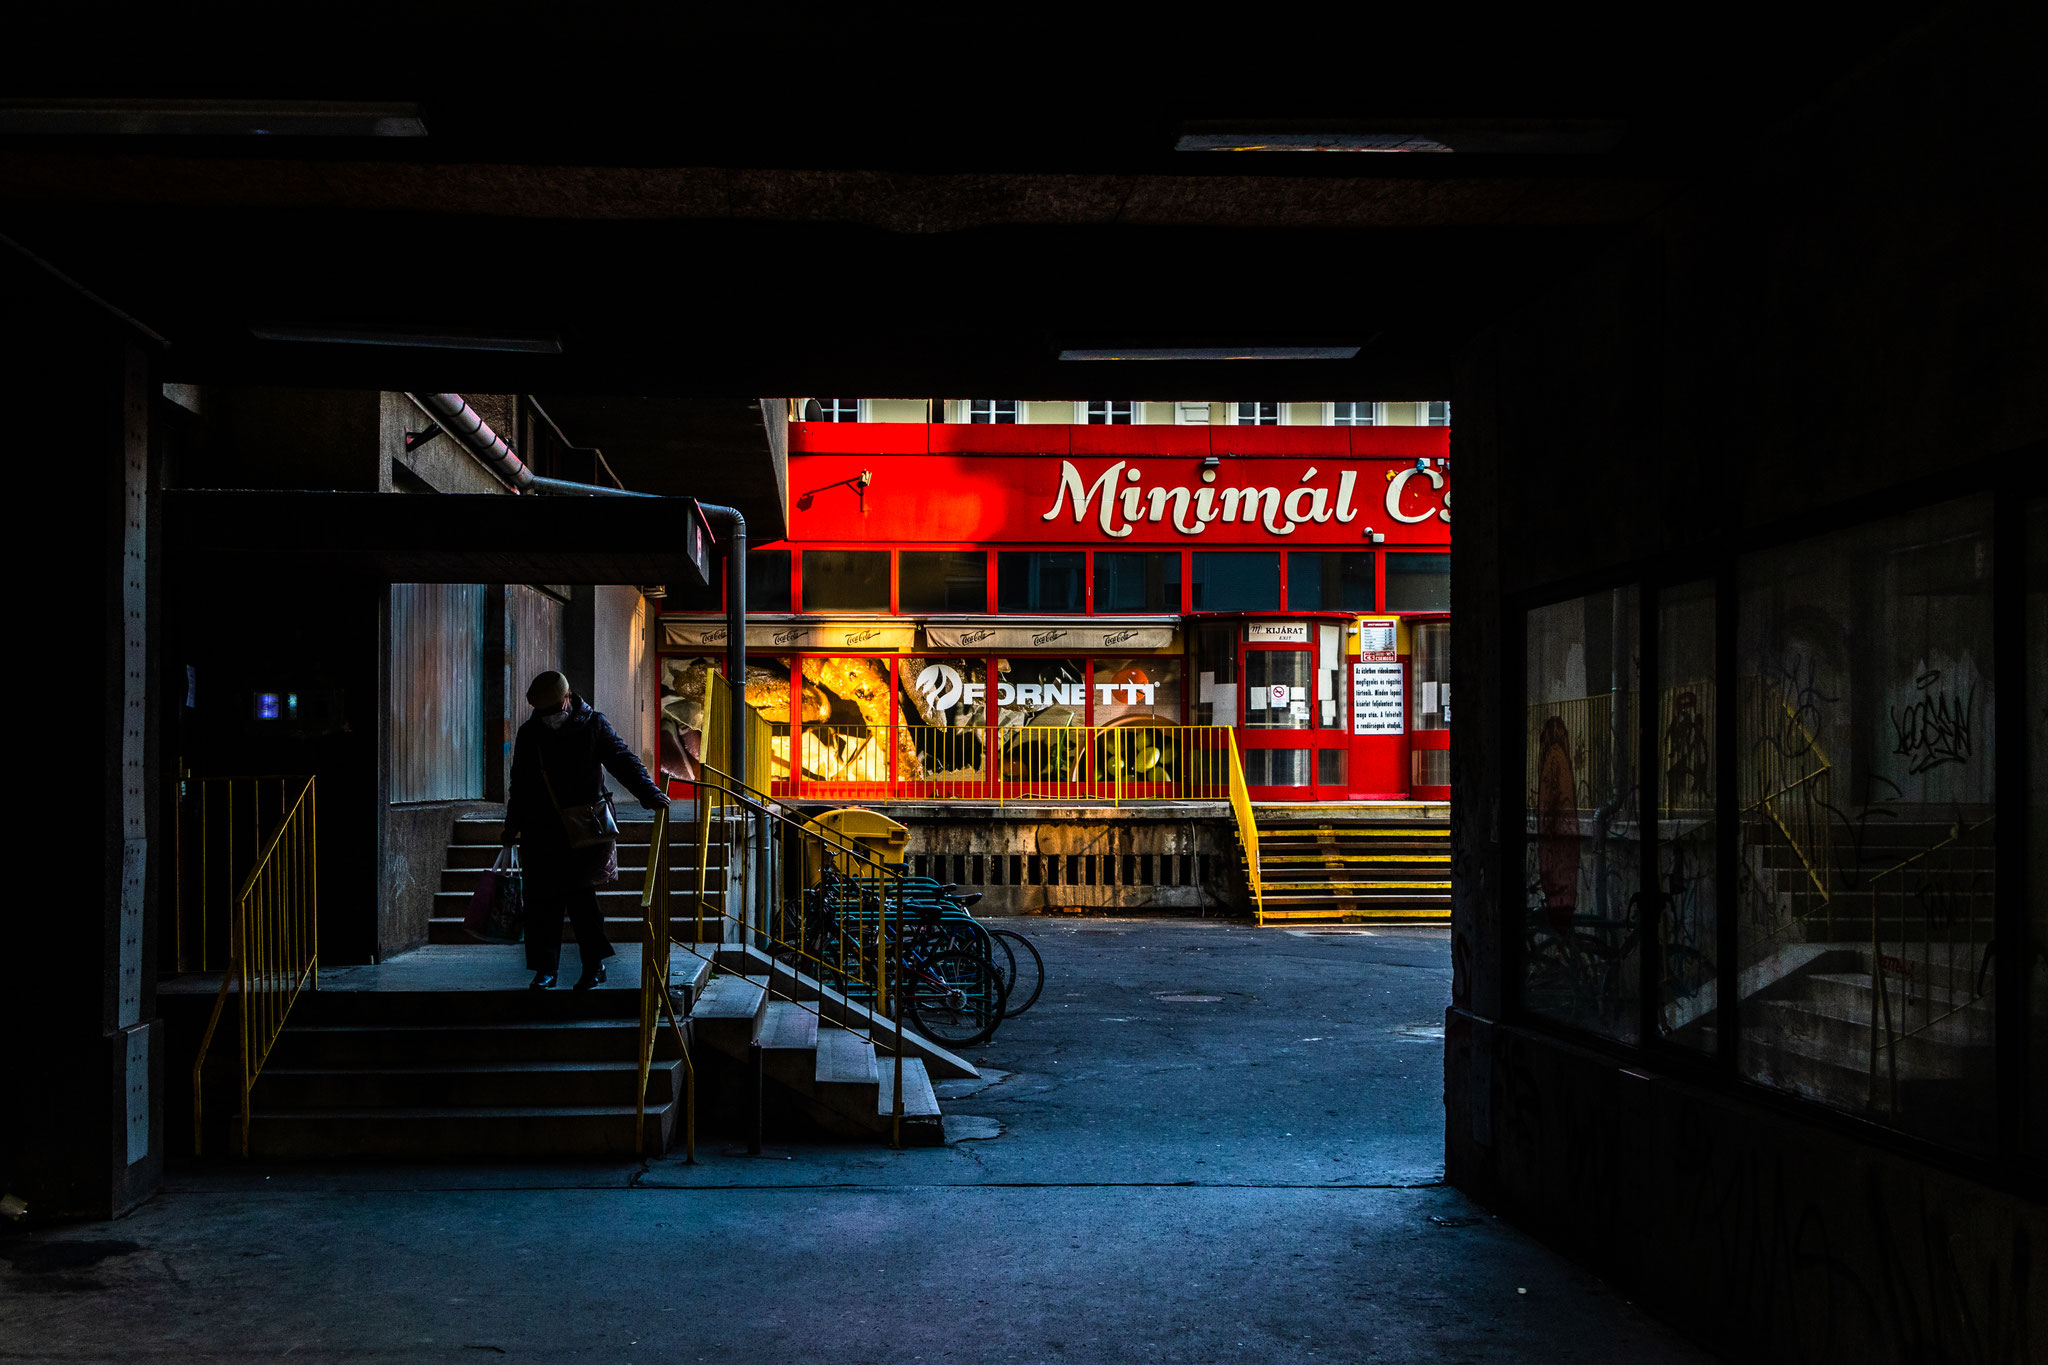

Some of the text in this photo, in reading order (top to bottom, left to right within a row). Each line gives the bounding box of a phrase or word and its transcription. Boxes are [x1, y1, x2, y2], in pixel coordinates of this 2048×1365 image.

[1043, 460, 1357, 538] Minimál
[1266, 626, 1304, 635] KIJÁRAT
[963, 683, 1155, 706] FORNETTI
